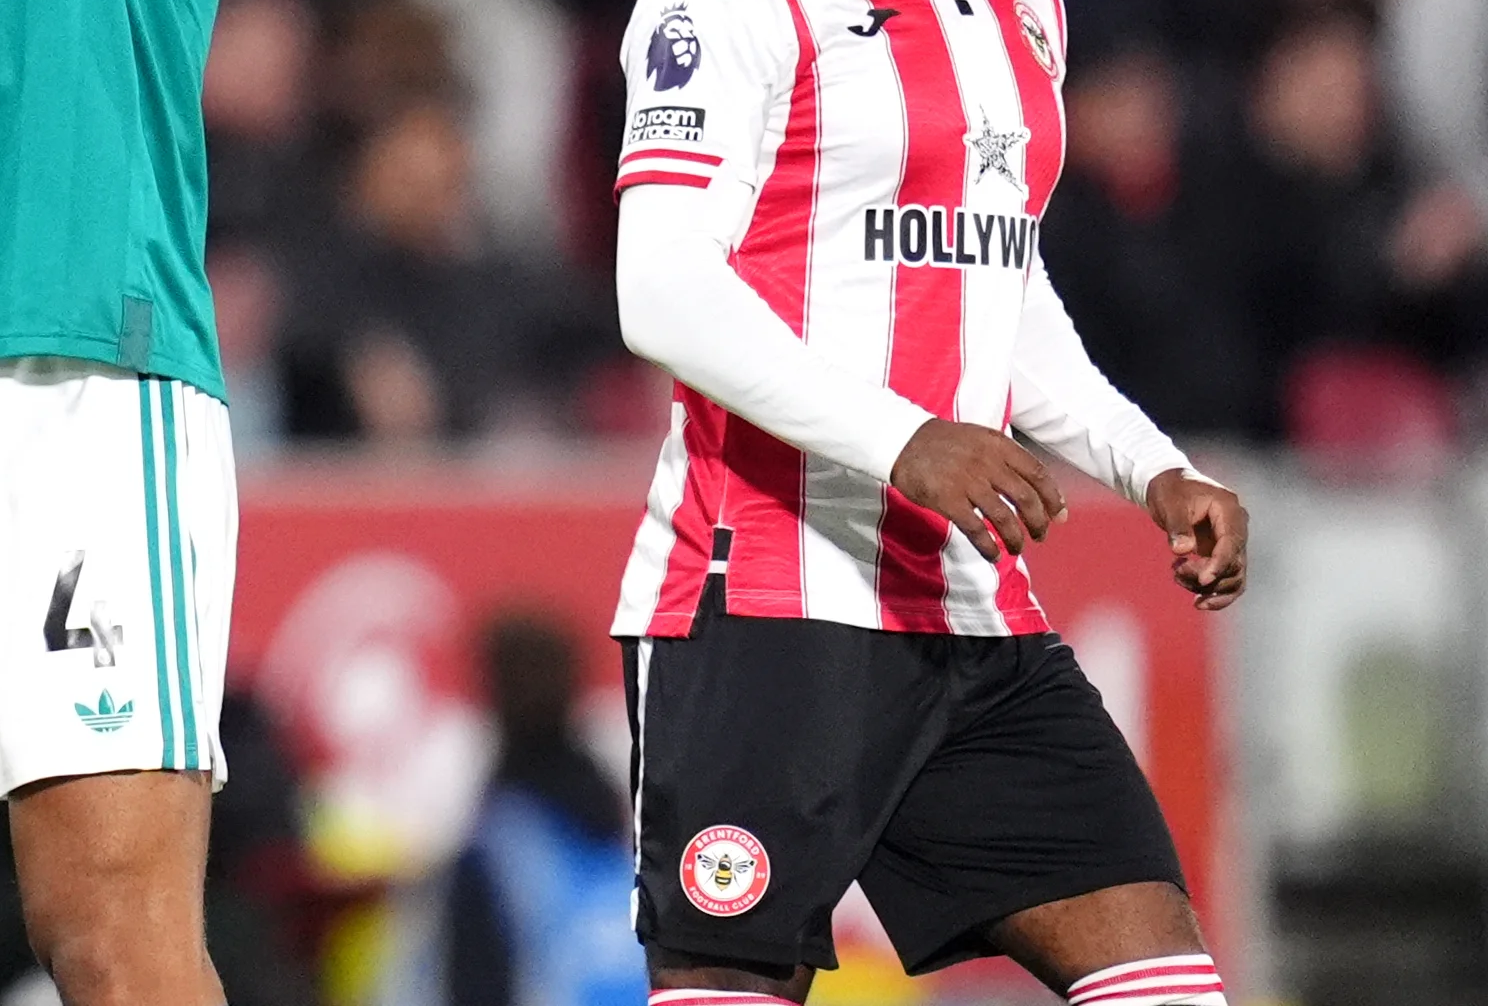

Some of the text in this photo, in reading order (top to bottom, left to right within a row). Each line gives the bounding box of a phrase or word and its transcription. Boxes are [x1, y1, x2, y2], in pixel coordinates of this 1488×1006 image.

[646, 109, 696, 127] room
[643, 125, 703, 142] racism
[43, 549, 124, 668] 4
[695, 829, 760, 855] BRENTFORD
[689, 886, 755, 912] FOOTBALL CLUB
